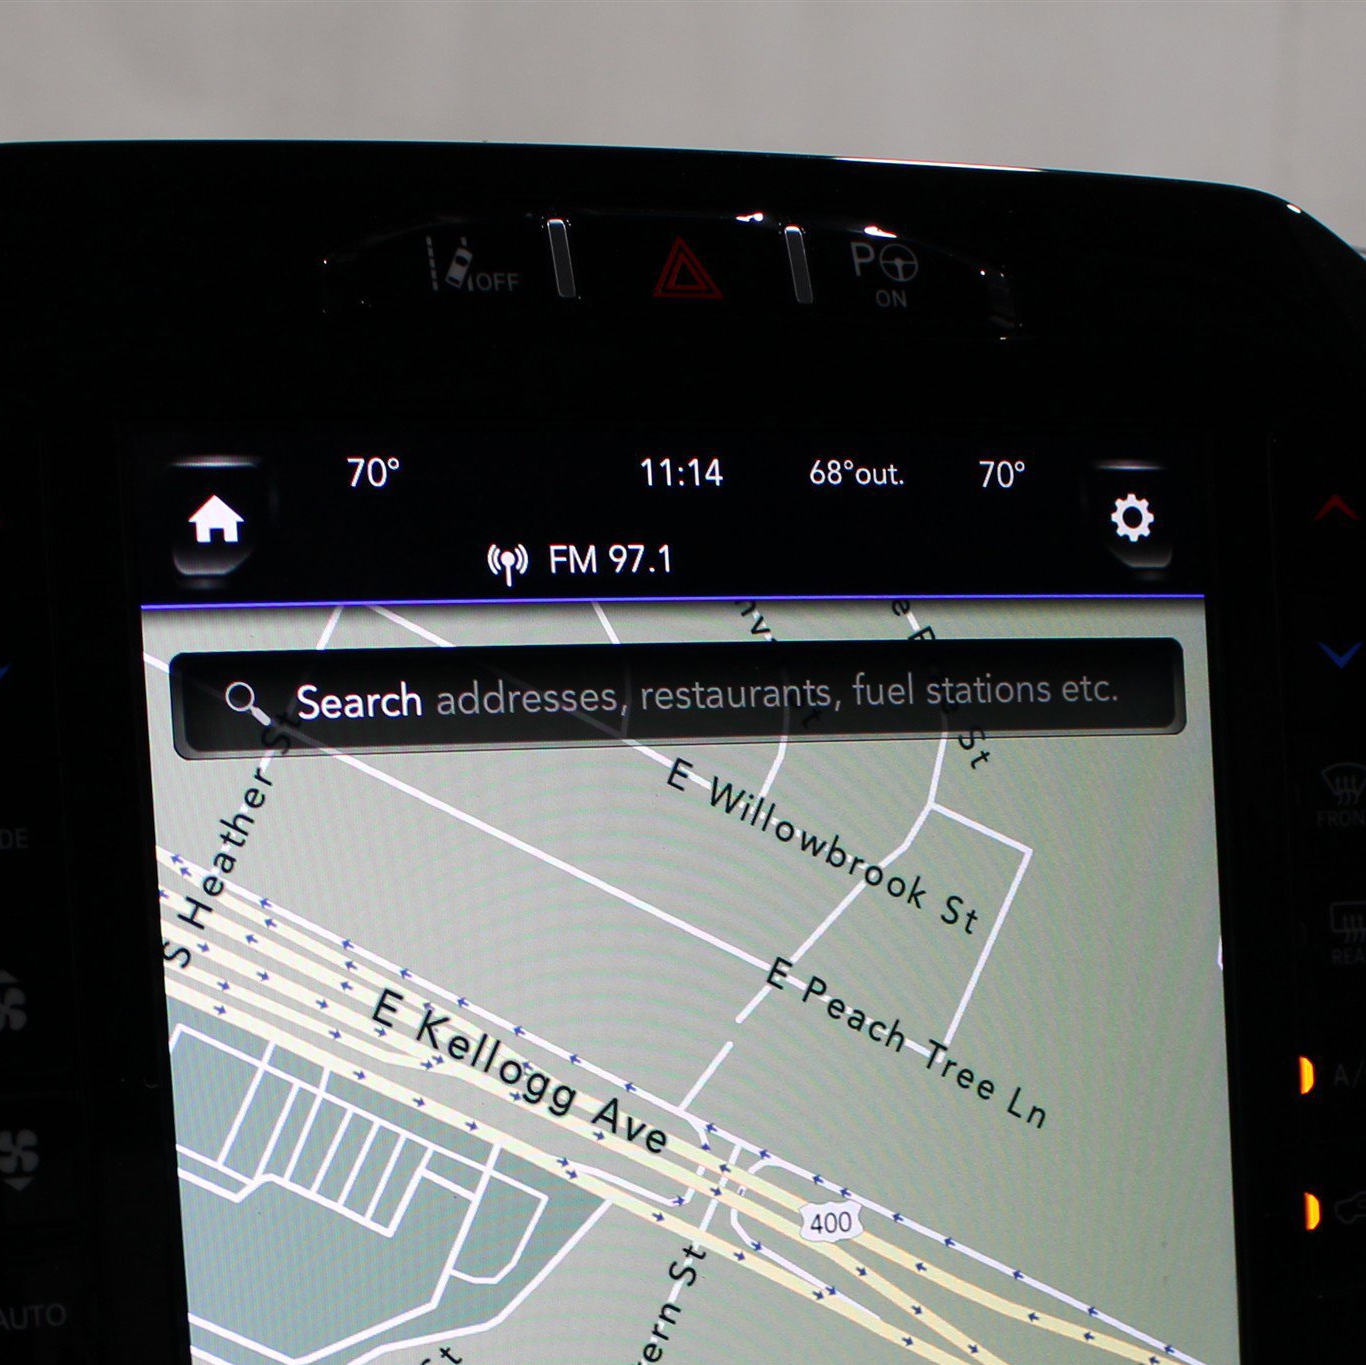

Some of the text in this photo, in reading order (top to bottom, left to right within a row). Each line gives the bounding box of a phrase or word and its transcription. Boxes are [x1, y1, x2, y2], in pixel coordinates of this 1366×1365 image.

[476, 272, 520, 292] OFF
[876, 289, 907, 308] ON
[346, 457, 400, 488] 70°
[641, 458, 723, 487] 11:14
[979, 460, 1026, 489] 70°
[549, 545, 672, 574] FM 97.1
[297, 681, 422, 721] Search
[437, 679, 628, 718] addresses,
[641, 677, 841, 712] restaurants,
[852, 671, 914, 705] fuel
[927, 672, 1051, 704] stations
[1061, 676, 1119, 702] etc.
[958, 726, 990, 769] St
[666, 757, 979, 936] E Willowbrook St
[160, 941, 191, 969] S
[177, 767, 273, 931] Heather
[766, 956, 1047, 1131] E Peach Tree Ln
[371, 988, 669, 1156] E Kellogg Ave
[809, 1210, 852, 1235] 400
[668, 1242, 708, 1288] St
